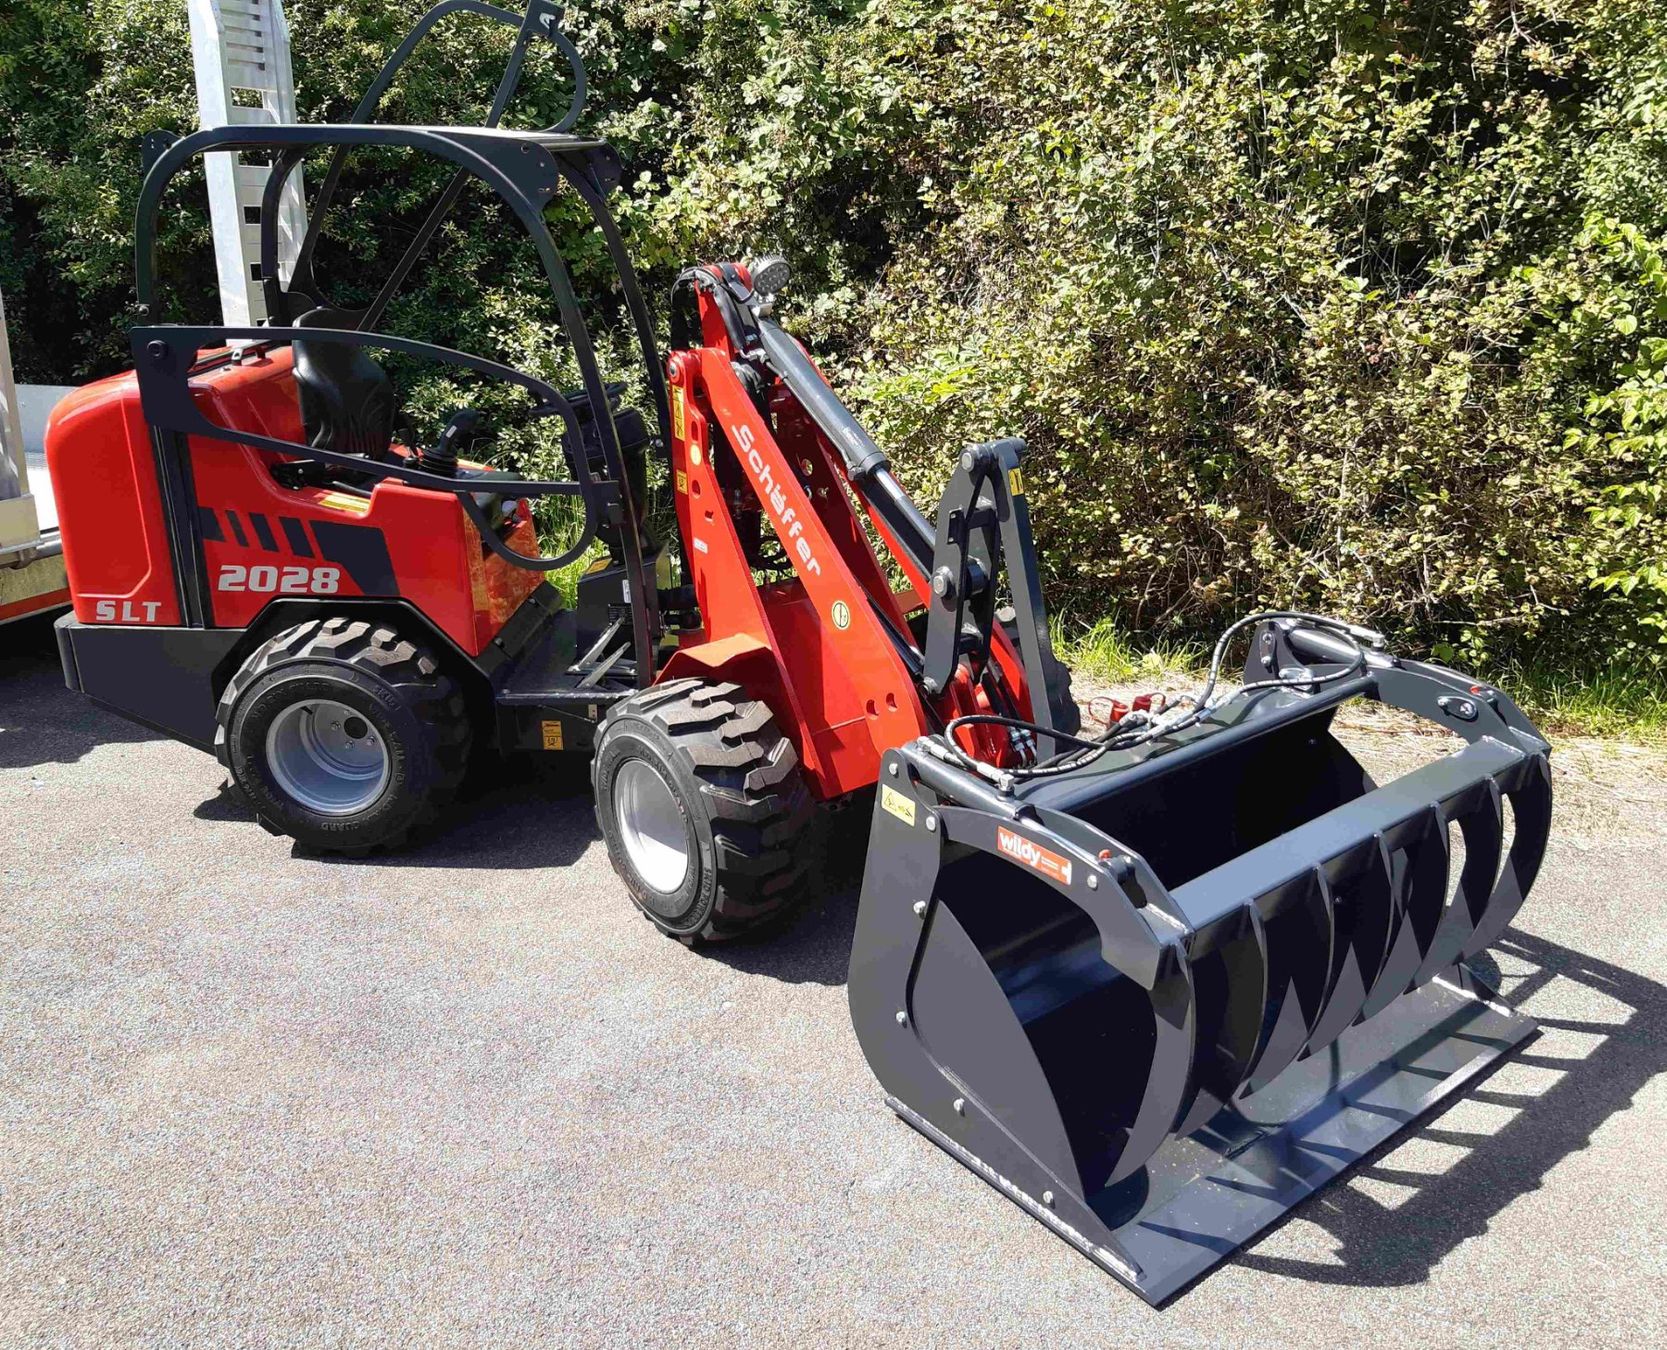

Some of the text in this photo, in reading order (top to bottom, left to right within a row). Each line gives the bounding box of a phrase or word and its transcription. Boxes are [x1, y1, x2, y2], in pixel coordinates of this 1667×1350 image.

[731, 424, 821, 576] Schäffer
[218, 564, 340, 594] 2028
[96, 600, 162, 622] SLT
[1000, 832, 1041, 867] wildy
